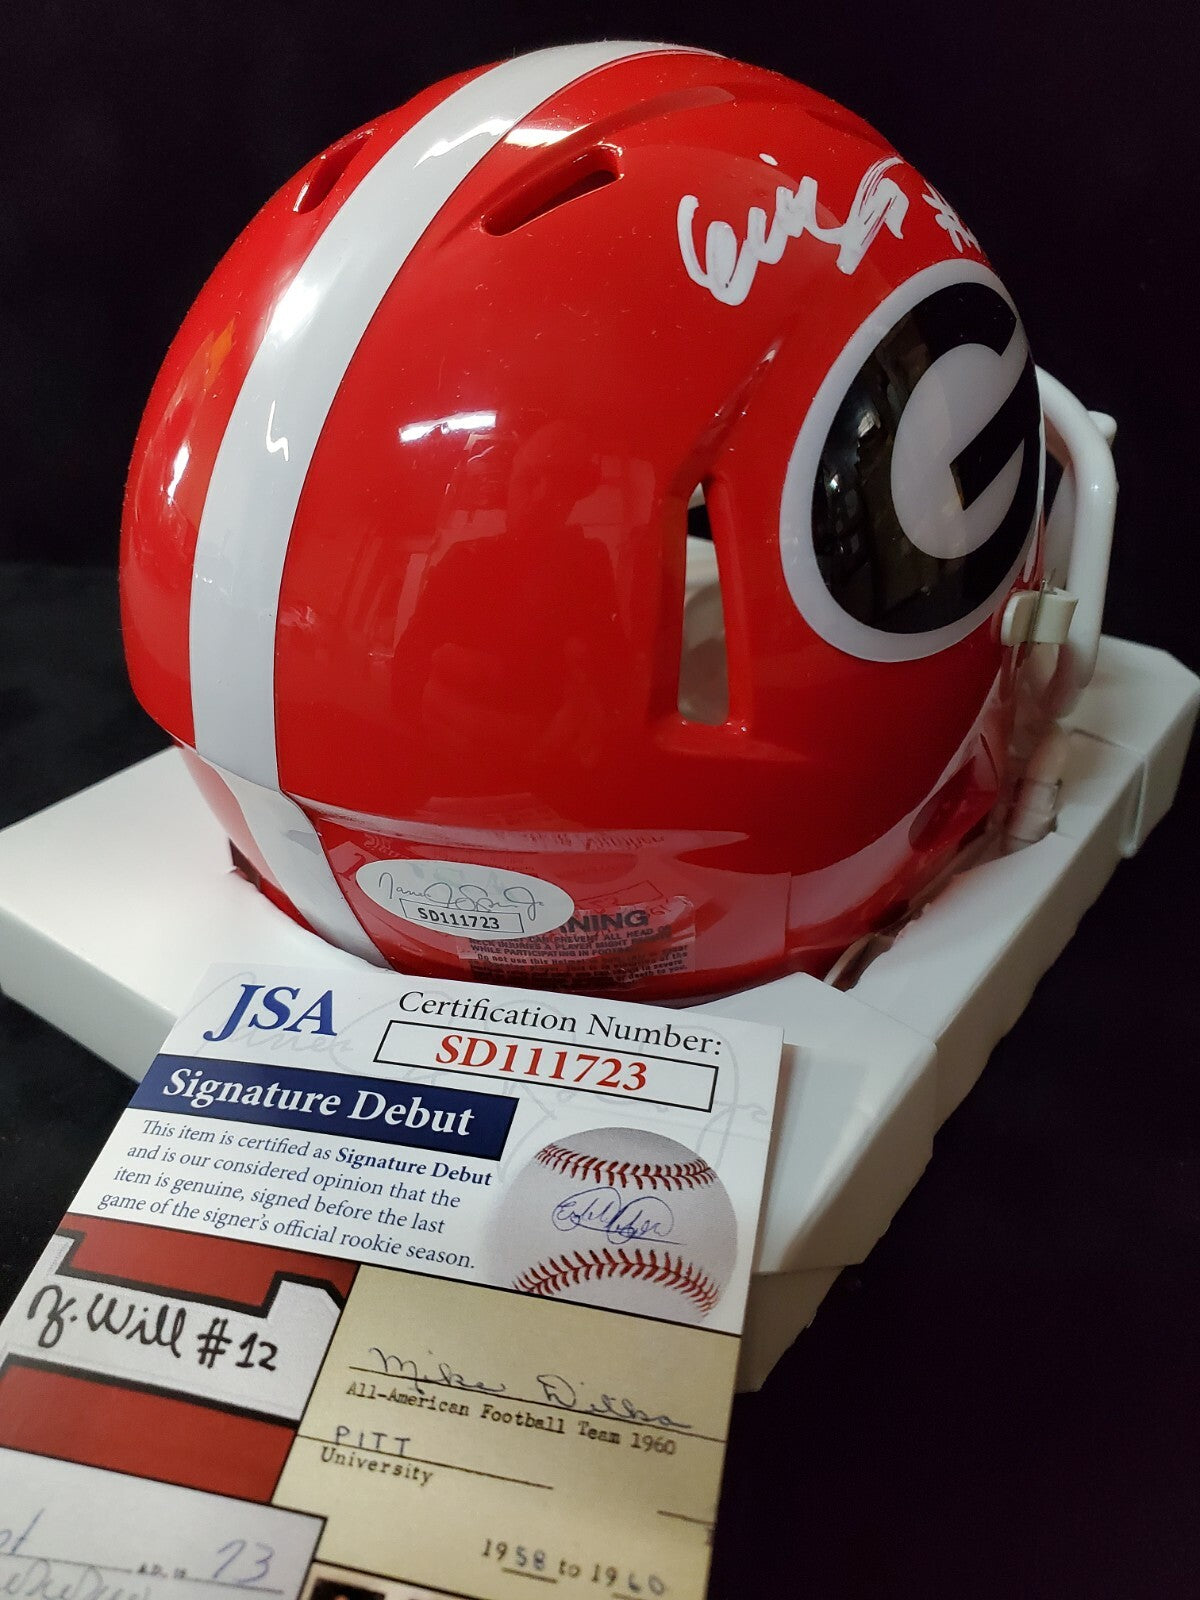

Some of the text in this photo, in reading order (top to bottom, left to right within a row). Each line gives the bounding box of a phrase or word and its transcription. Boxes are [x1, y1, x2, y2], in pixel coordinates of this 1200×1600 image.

[417, 907, 500, 930] SD111723
[203, 983, 339, 1042] JSA
[398, 991, 724, 1056] Certification Number:
[435, 1033, 648, 1092] SD111723
[163, 1067, 475, 1137] Signature Debut
[127, 1145, 461, 1208] and is our considered opinion that the
[142, 1119, 493, 1186] This item is certified as Signature Debut
[97, 1193, 147, 1211] game
[150, 1199, 174, 1214] of
[171, 1201, 200, 1219] the
[273, 1218, 338, 1243] official
[339, 1232, 402, 1256] rookie
[406, 1244, 475, 1270] season.
[113, 1166, 446, 1234] item is genuine, signed before the last
[87, 1293, 186, 1358] Will
[197, 1317, 278, 1371] #12
[334, 1425, 412, 1456] PITT
[346, 1382, 677, 1456] All-American Football Team 1960
[320, 1446, 435, 1487] University
[558, 1548, 582, 1578] to
